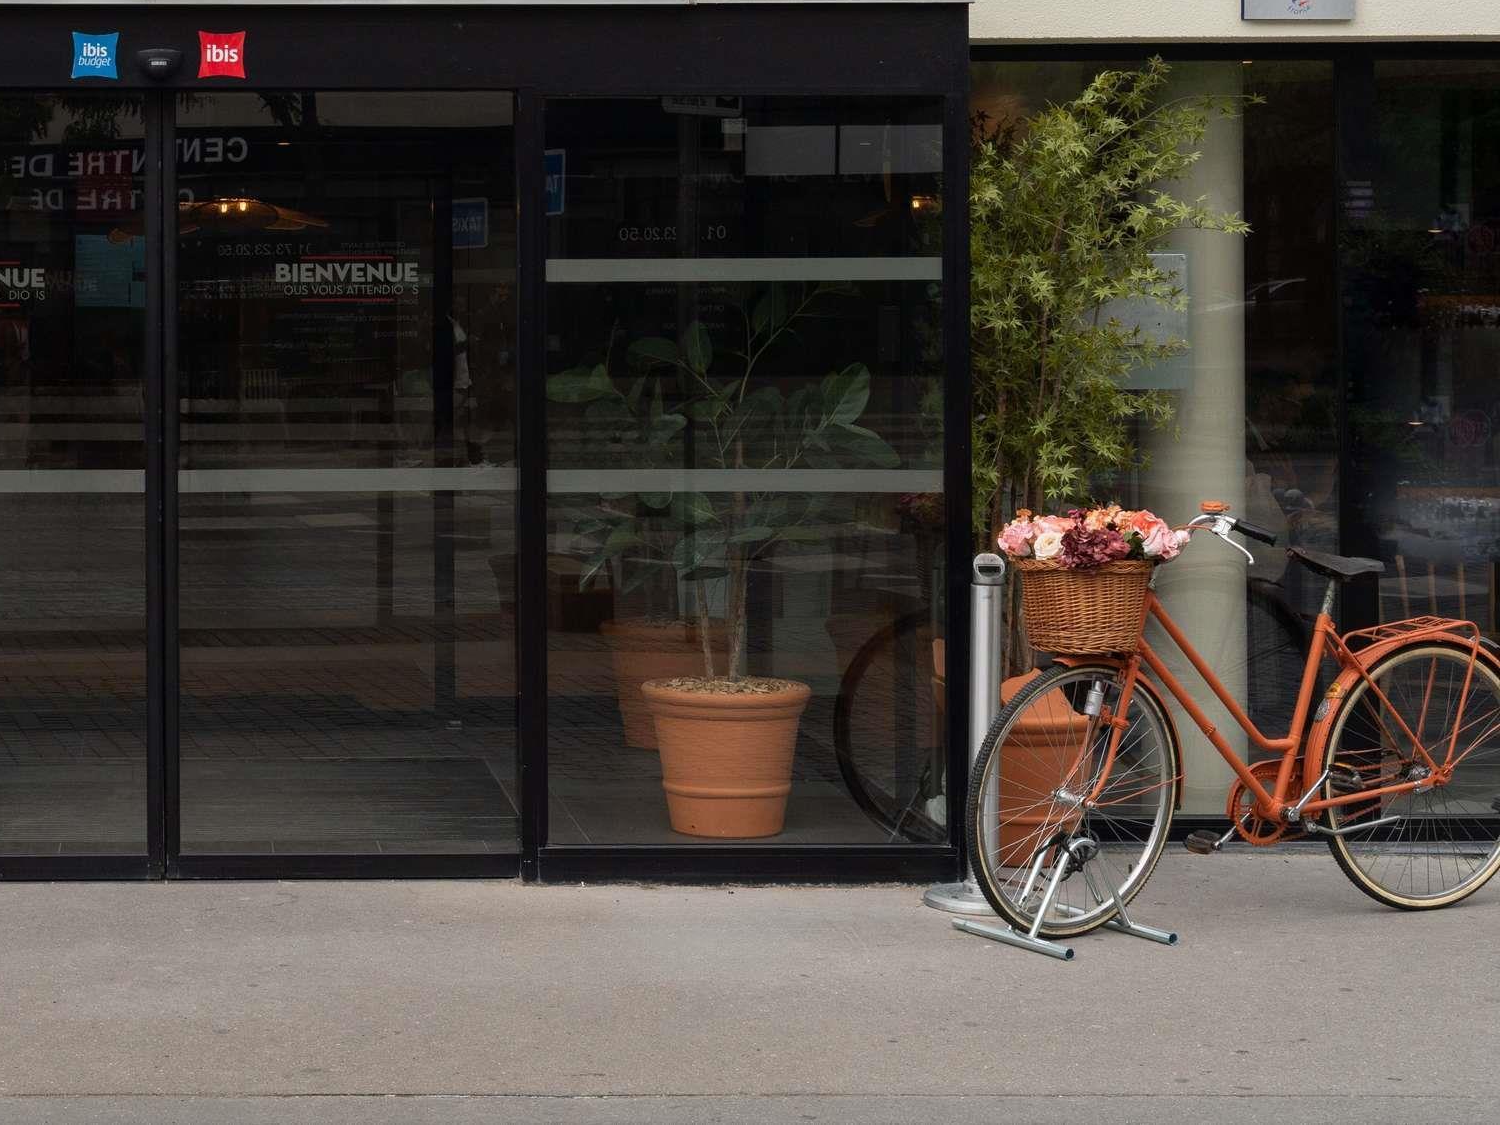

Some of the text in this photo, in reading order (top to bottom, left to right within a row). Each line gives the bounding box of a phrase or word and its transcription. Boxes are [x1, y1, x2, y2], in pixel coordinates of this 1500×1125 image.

[82, 43, 108, 57] ibis
[206, 44, 239, 63] ibis
[77, 56, 113, 69] budget
[275, 262, 419, 283] BIENVENUE
[311, 284, 344, 296] VOUS
[346, 284, 419, 296] ATTENDIOS
